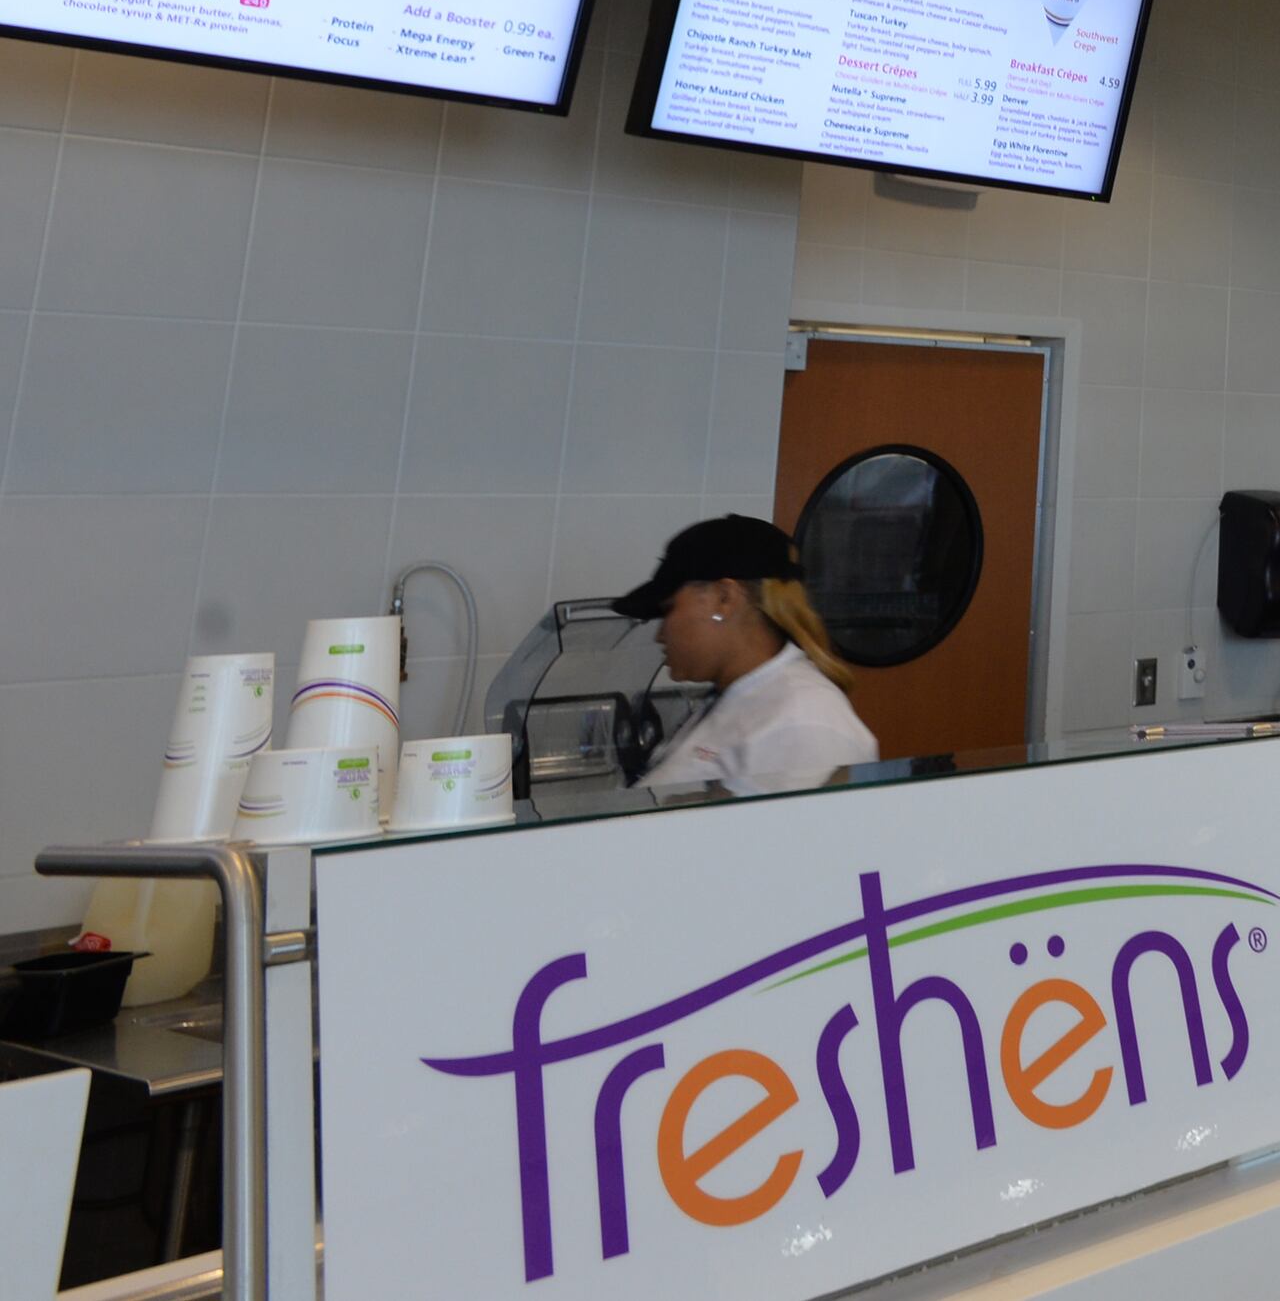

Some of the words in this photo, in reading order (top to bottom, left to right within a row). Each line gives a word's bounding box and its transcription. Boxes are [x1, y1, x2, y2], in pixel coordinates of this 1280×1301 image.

[331, 16, 374, 32] Protein
[403, 4, 431, 18] Add
[434, 11, 442, 20] a
[446, 11, 496, 29] Booster
[503, 19, 536, 37] 0.99
[536, 29, 555, 40] ea.
[879, 14, 908, 29] Turkey
[326, 33, 360, 47] Focus
[399, 28, 433, 43] Mega
[435, 34, 475, 51] Energy
[396, 44, 437, 59] Xtreme
[502, 45, 535, 58] Green
[537, 50, 556, 62] Tea
[759, 41, 789, 56] Turkey
[838, 55, 879, 72] Dessert
[974, 78, 997, 92] 5.99
[750, 92, 785, 104] Chicken
[971, 91, 994, 105] 3.99
